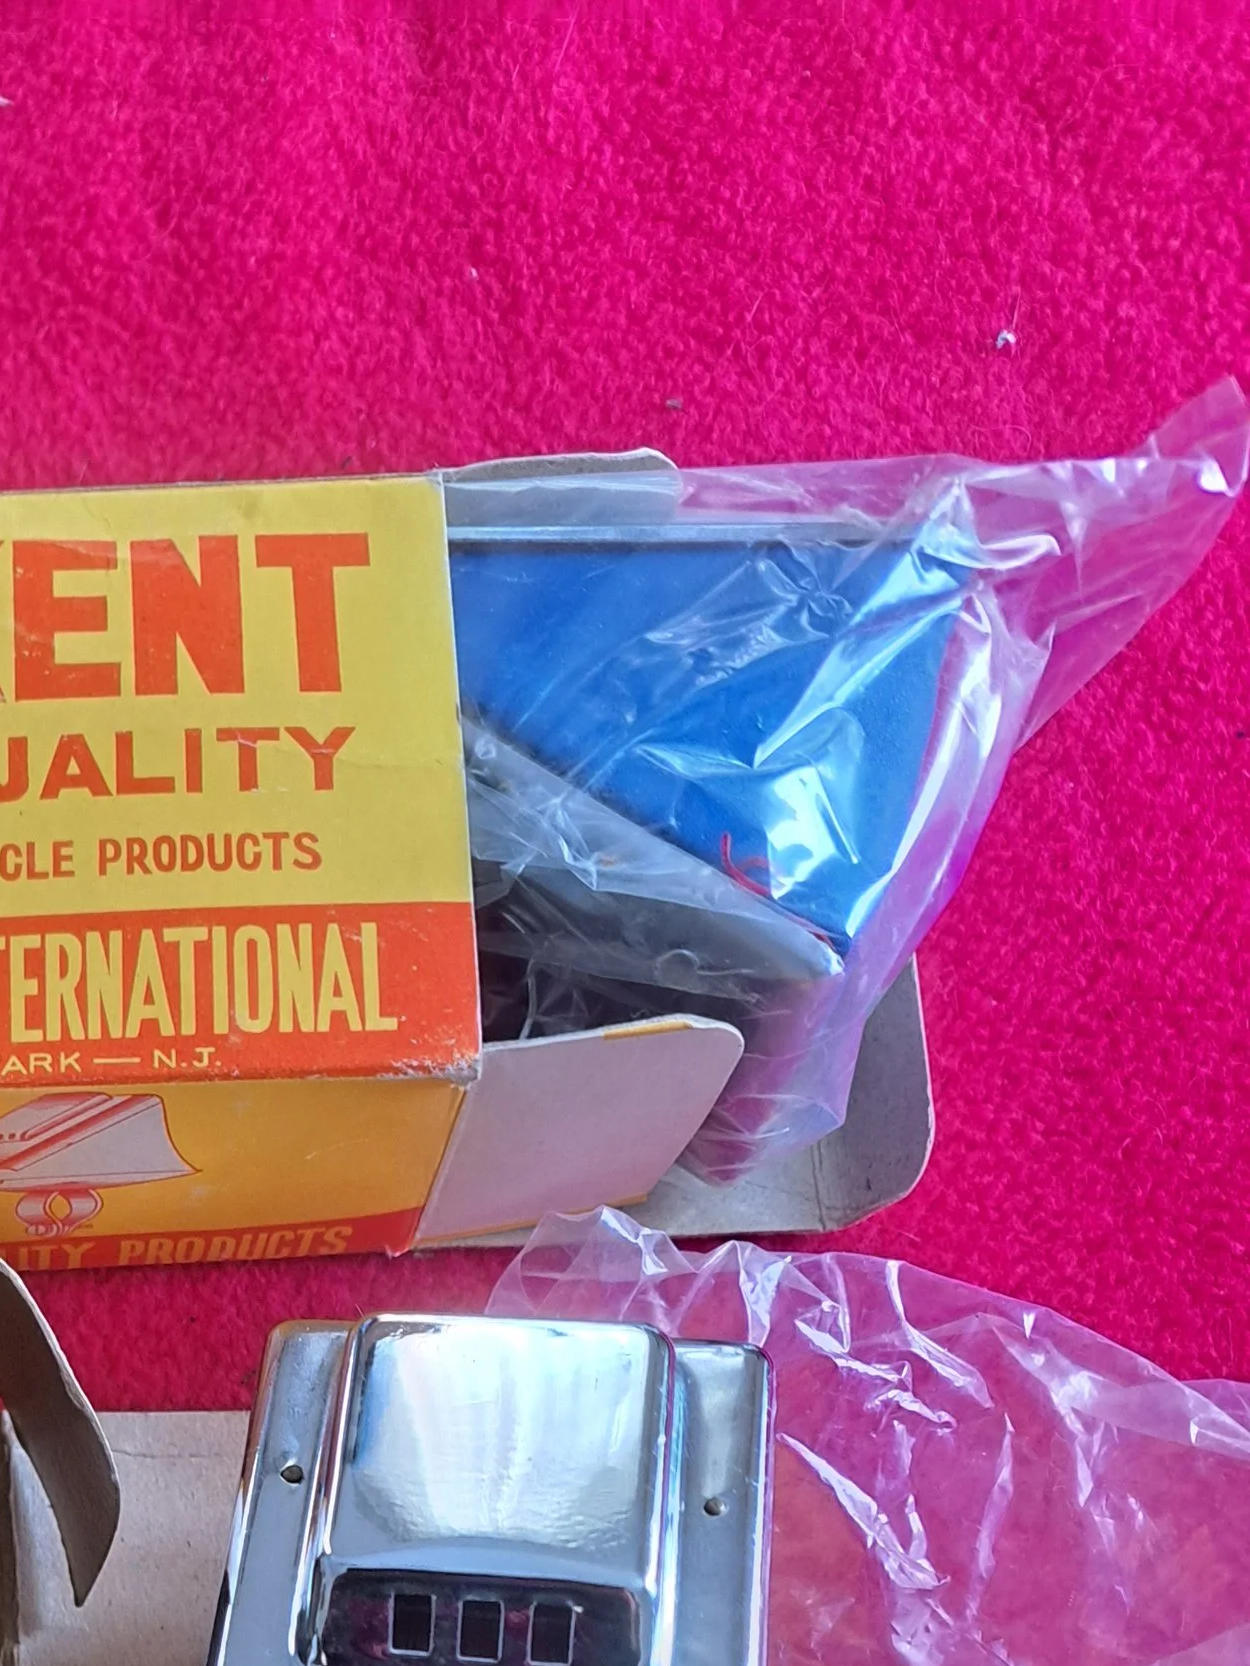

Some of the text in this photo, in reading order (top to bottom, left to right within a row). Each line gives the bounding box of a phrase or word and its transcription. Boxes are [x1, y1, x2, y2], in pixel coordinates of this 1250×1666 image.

[97, 830, 323, 877] PRODUCTS
[152, 1046, 223, 1070] N.J.
[118, 1225, 354, 1267] PRODUCTS
